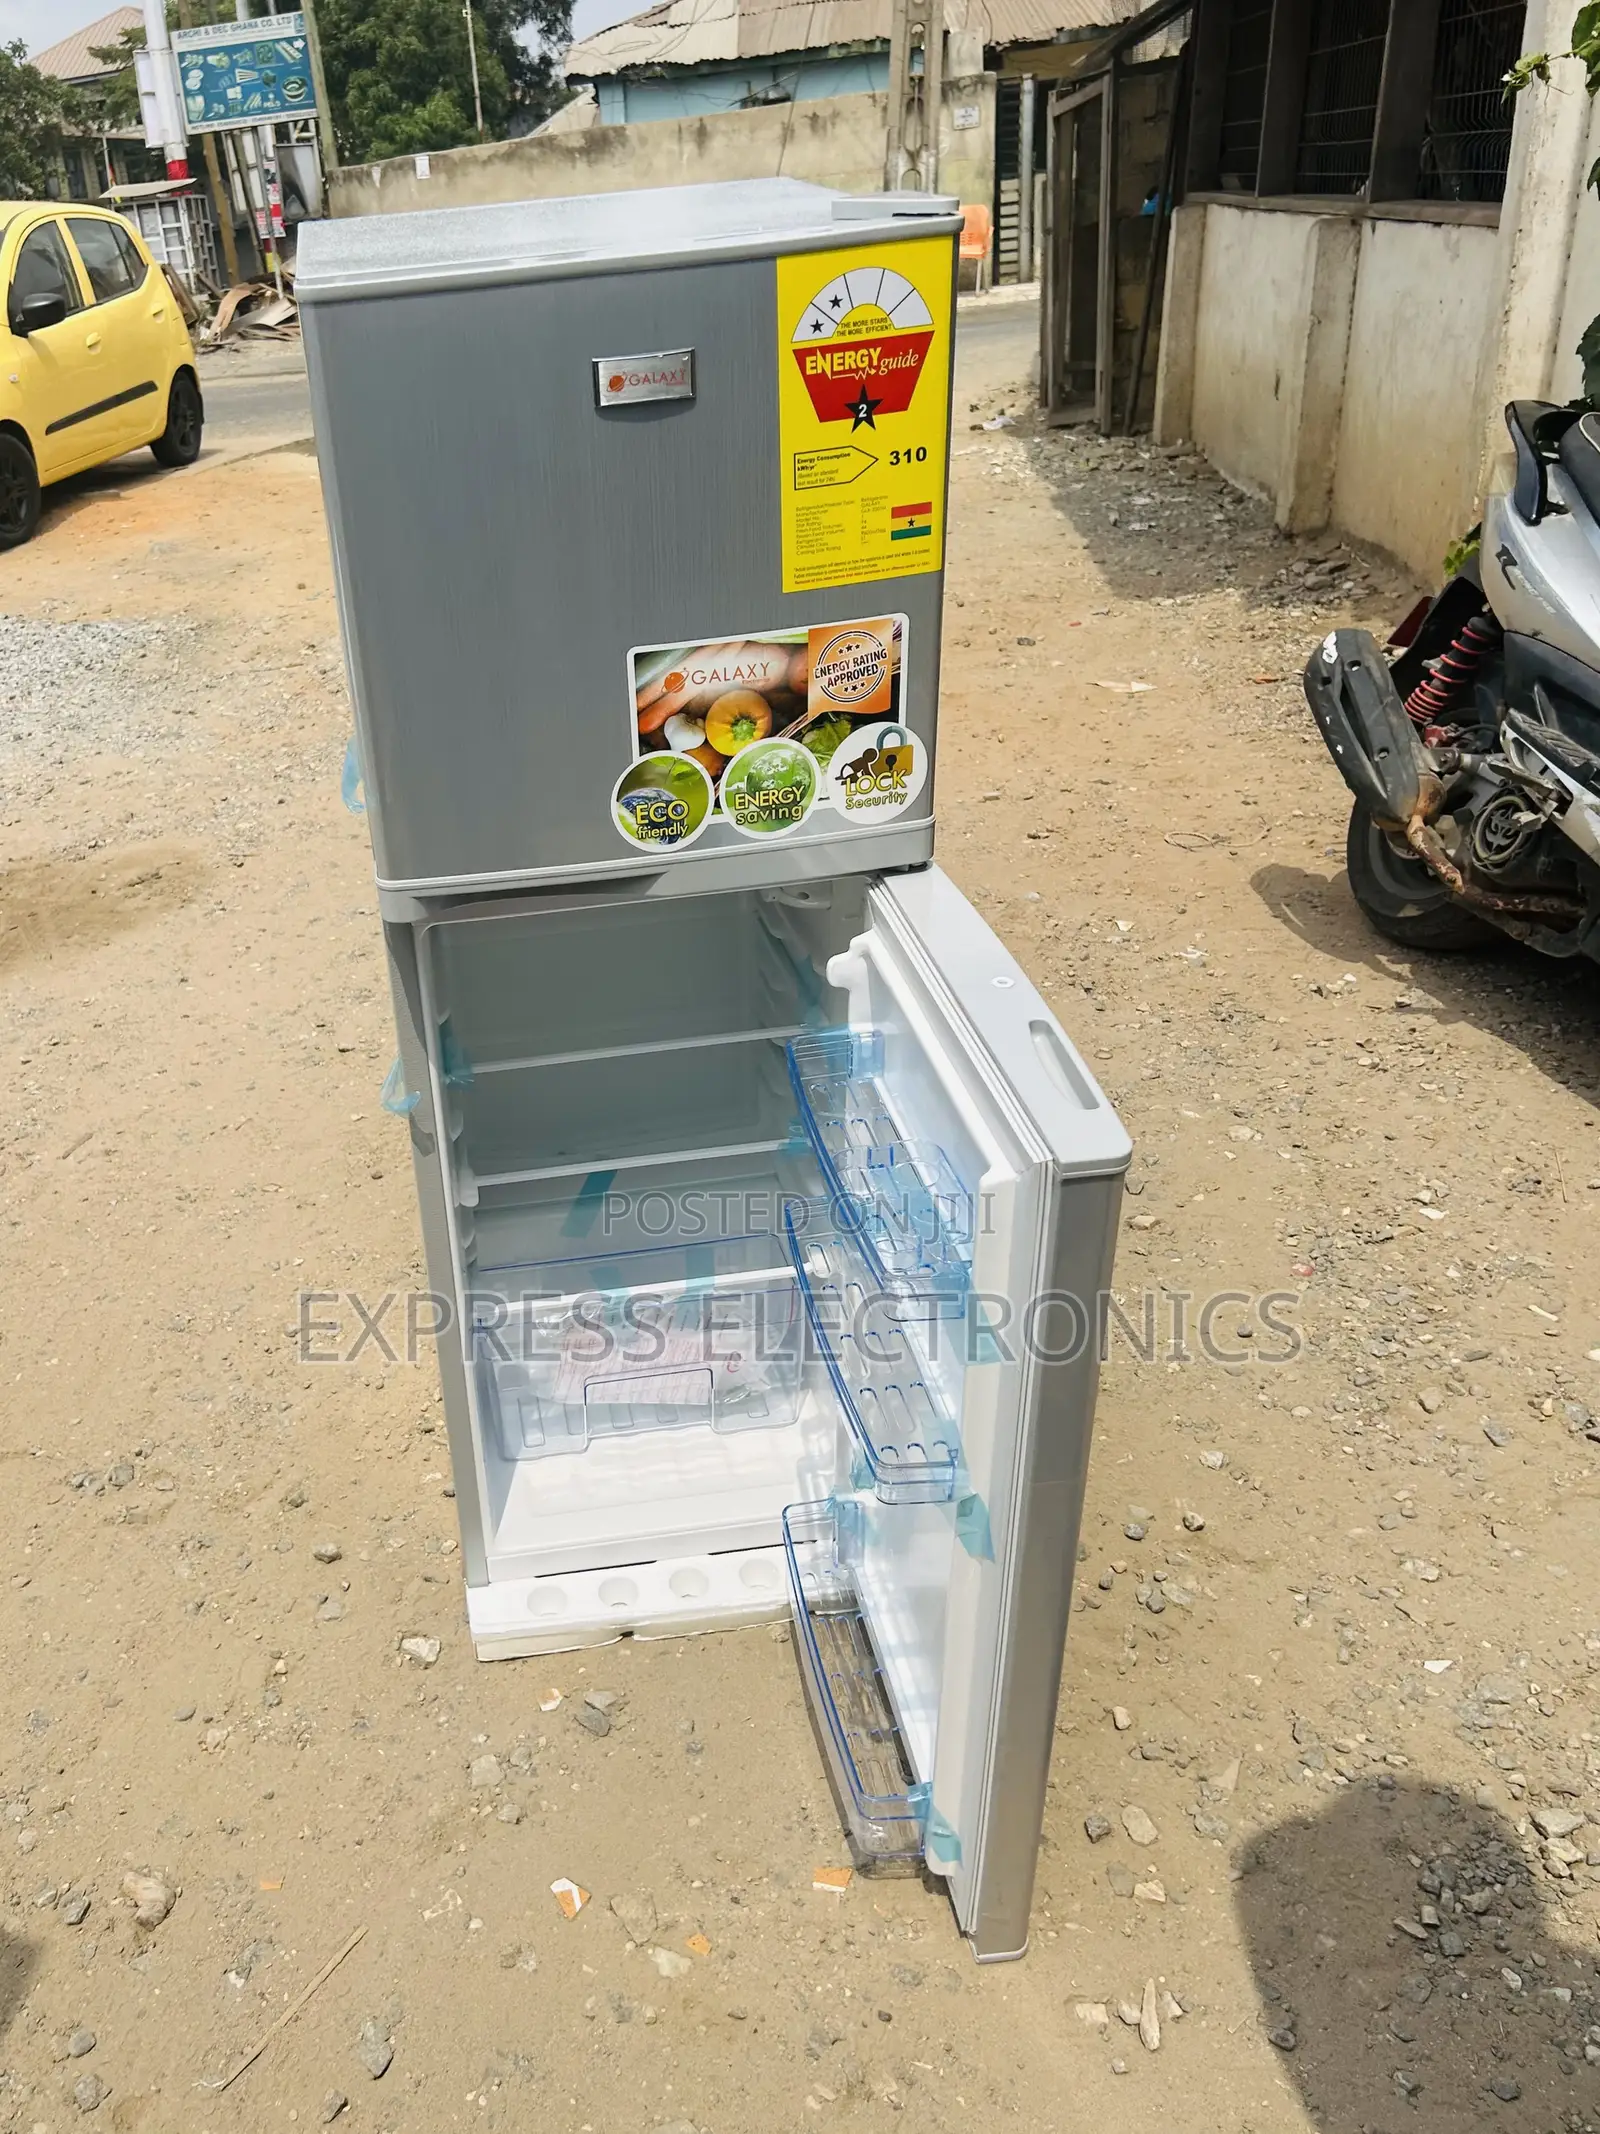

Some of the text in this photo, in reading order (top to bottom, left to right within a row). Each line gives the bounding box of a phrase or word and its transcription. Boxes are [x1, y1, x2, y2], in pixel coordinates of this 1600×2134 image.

[230, 21, 259, 32] GHANA
[805, 347, 919, 380] ENERGY guide
[628, 367, 687, 386] GALAXY
[858, 403, 868, 418] 2
[889, 446, 928, 466] 310
[691, 661, 771, 686] GALAXY
[814, 648, 888, 679] ENERGY RATING
[827, 663, 879, 689] APPROVED
[845, 771, 908, 798] LOCK
[734, 786, 806, 811] ENERGY
[845, 790, 909, 810] Security
[635, 800, 690, 825] ECO
[735, 804, 804, 826] saving
[636, 823, 689, 840] friendly
